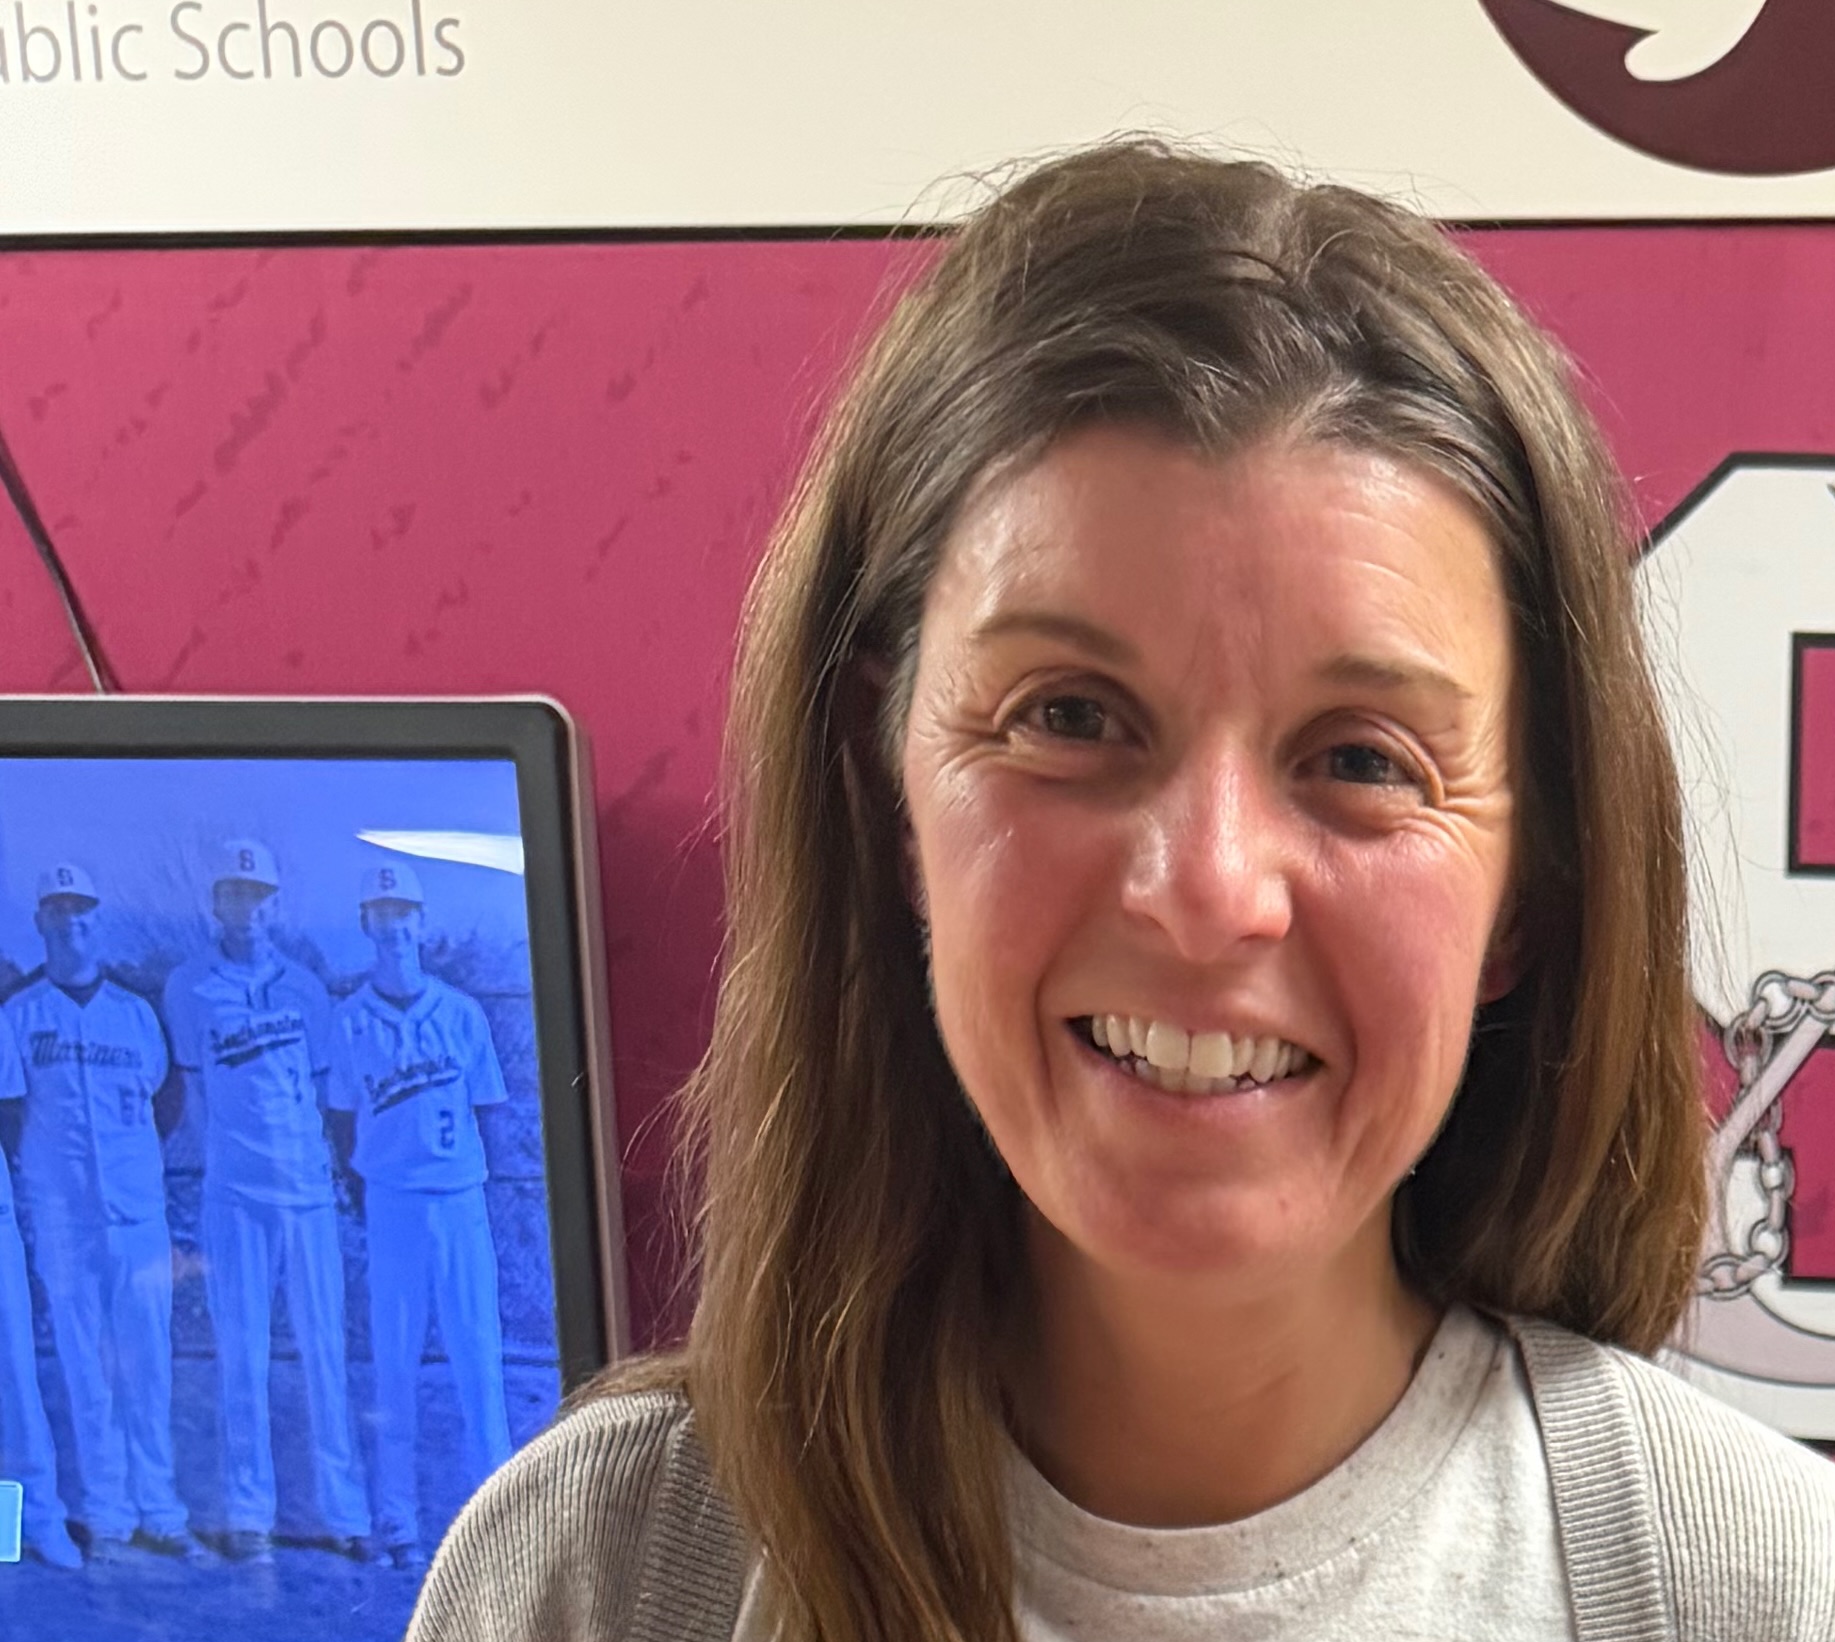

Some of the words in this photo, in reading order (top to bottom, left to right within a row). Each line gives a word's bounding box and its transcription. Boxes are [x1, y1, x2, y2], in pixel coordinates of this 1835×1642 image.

[0, 0, 148, 84] blic
[169, 0, 467, 82] Schools
[439, 1109, 456, 1151] 2
